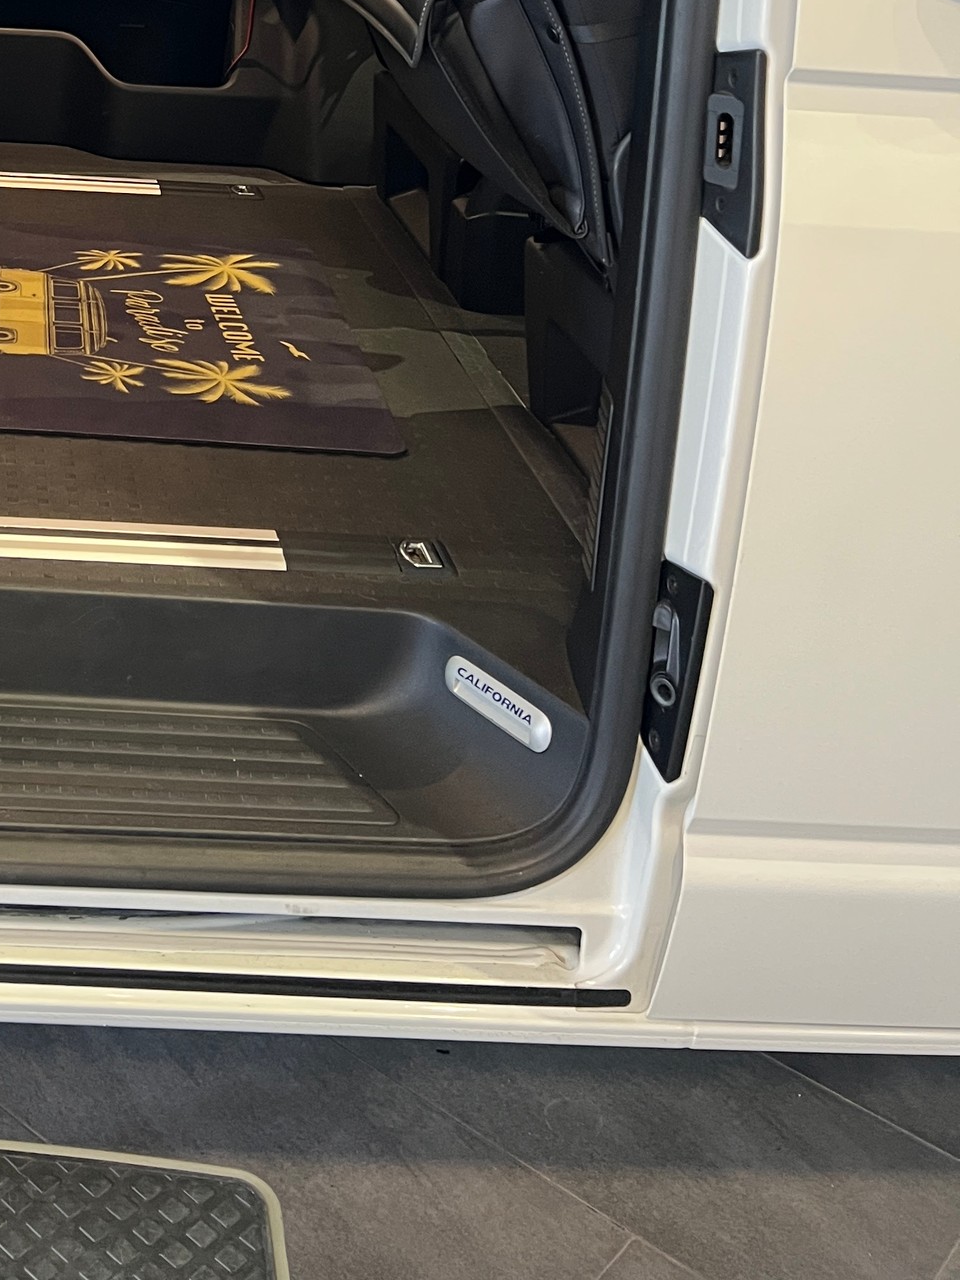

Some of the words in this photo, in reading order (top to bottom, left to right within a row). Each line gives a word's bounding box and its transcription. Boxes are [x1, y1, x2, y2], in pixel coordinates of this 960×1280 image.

[110, 289, 189, 353] Paradise
[184, 319, 205, 331] to
[205, 293, 265, 362] WELCOME
[457, 667, 532, 726] CALIFORNIA
